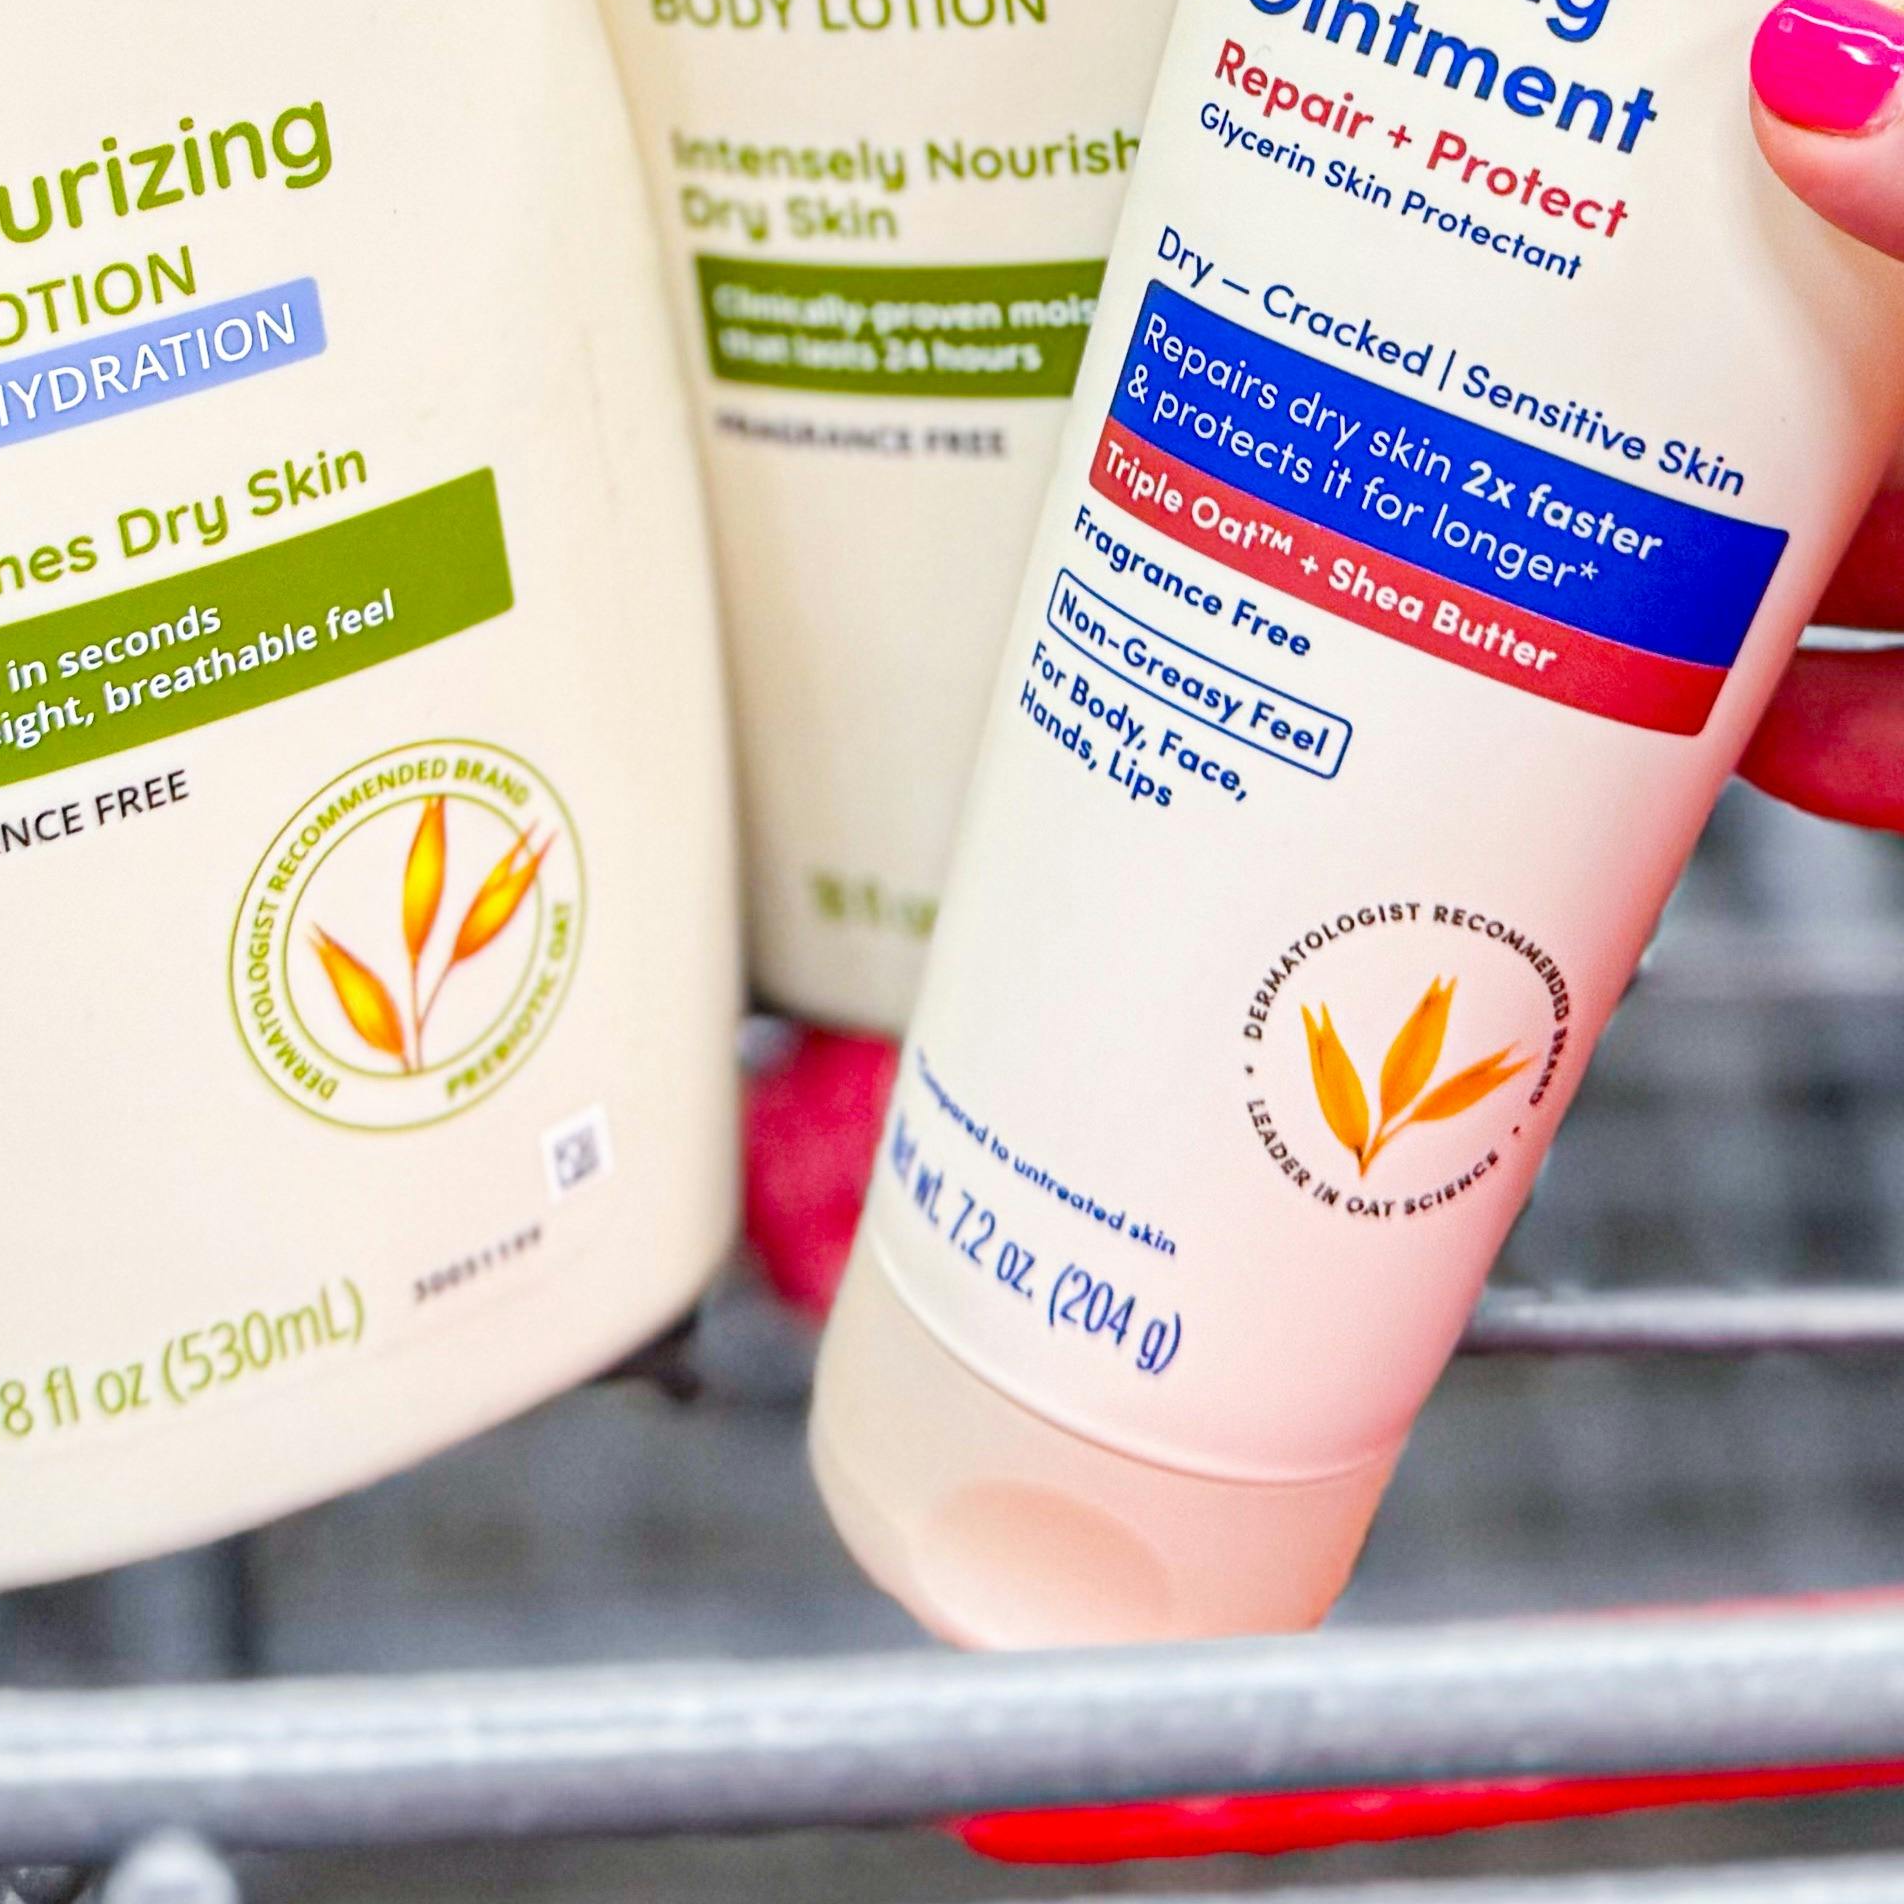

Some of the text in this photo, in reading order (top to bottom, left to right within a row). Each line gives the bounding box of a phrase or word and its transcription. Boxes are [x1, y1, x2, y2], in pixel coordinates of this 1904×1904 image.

[671, 130, 906, 191] Intensely
[1200, 102, 1582, 280] Glycerin Skin Protectant
[1215, 38, 1374, 139] Repair
[1426, 130, 1628, 238] Protect
[681, 187, 898, 241] Dry Skin
[932, 338, 1042, 373] hours
[1156, 225, 1213, 290] Dry
[1263, 284, 1434, 378] Cracked
[1462, 364, 1646, 461] Sensitive
[1659, 440, 1745, 497] Skin
[116, 492, 228, 560] Dry
[247, 444, 369, 519] Skin
[925, 427, 1007, 456] FREE
[1127, 367, 1149, 403] &
[1153, 386, 1313, 485] protects
[1322, 459, 1351, 496] it
[1362, 480, 1424, 530] for
[1143, 313, 1663, 563] Repairs dry skin 2x faster
[1073, 506, 1312, 658] Fragrance Free
[1102, 442, 1185, 515] Triple
[1327, 558, 1426, 624] Shea
[1433, 603, 1558, 672] Butter
[7, 657, 48, 694] in
[57, 602, 223, 675] seconds
[104, 625, 318, 715] breathable
[325, 588, 396, 641] feel
[1031, 640, 1250, 800] For Body, Face,
[1058, 585, 1329, 760] Non-Greasy Feel
[95, 768, 192, 827] FREE
[1019, 686, 1173, 809] Hands, Lips
[248, 758, 530, 1102] DERMATOLOGIST RECOMMENDED BRAND
[1243, 902, 1420, 1042] DERMATOLOGIST
[1432, 904, 1571, 1023] RECOMMENDED
[990, 1135, 1009, 1163] to
[1014, 1155, 1126, 1231] untreated
[1129, 1218, 1177, 1256] skin
[1247, 1098, 1499, 1219] LEADER IN OAT SCIENCE
[44, 1365, 80, 1428] fl
[95, 1362, 150, 1419] oz
[160, 1276, 366, 1405] (530mL)
[949, 1190, 996, 1265] 7.2
[1047, 1261, 1137, 1346] (204
[1137, 1311, 1183, 1375] g)
